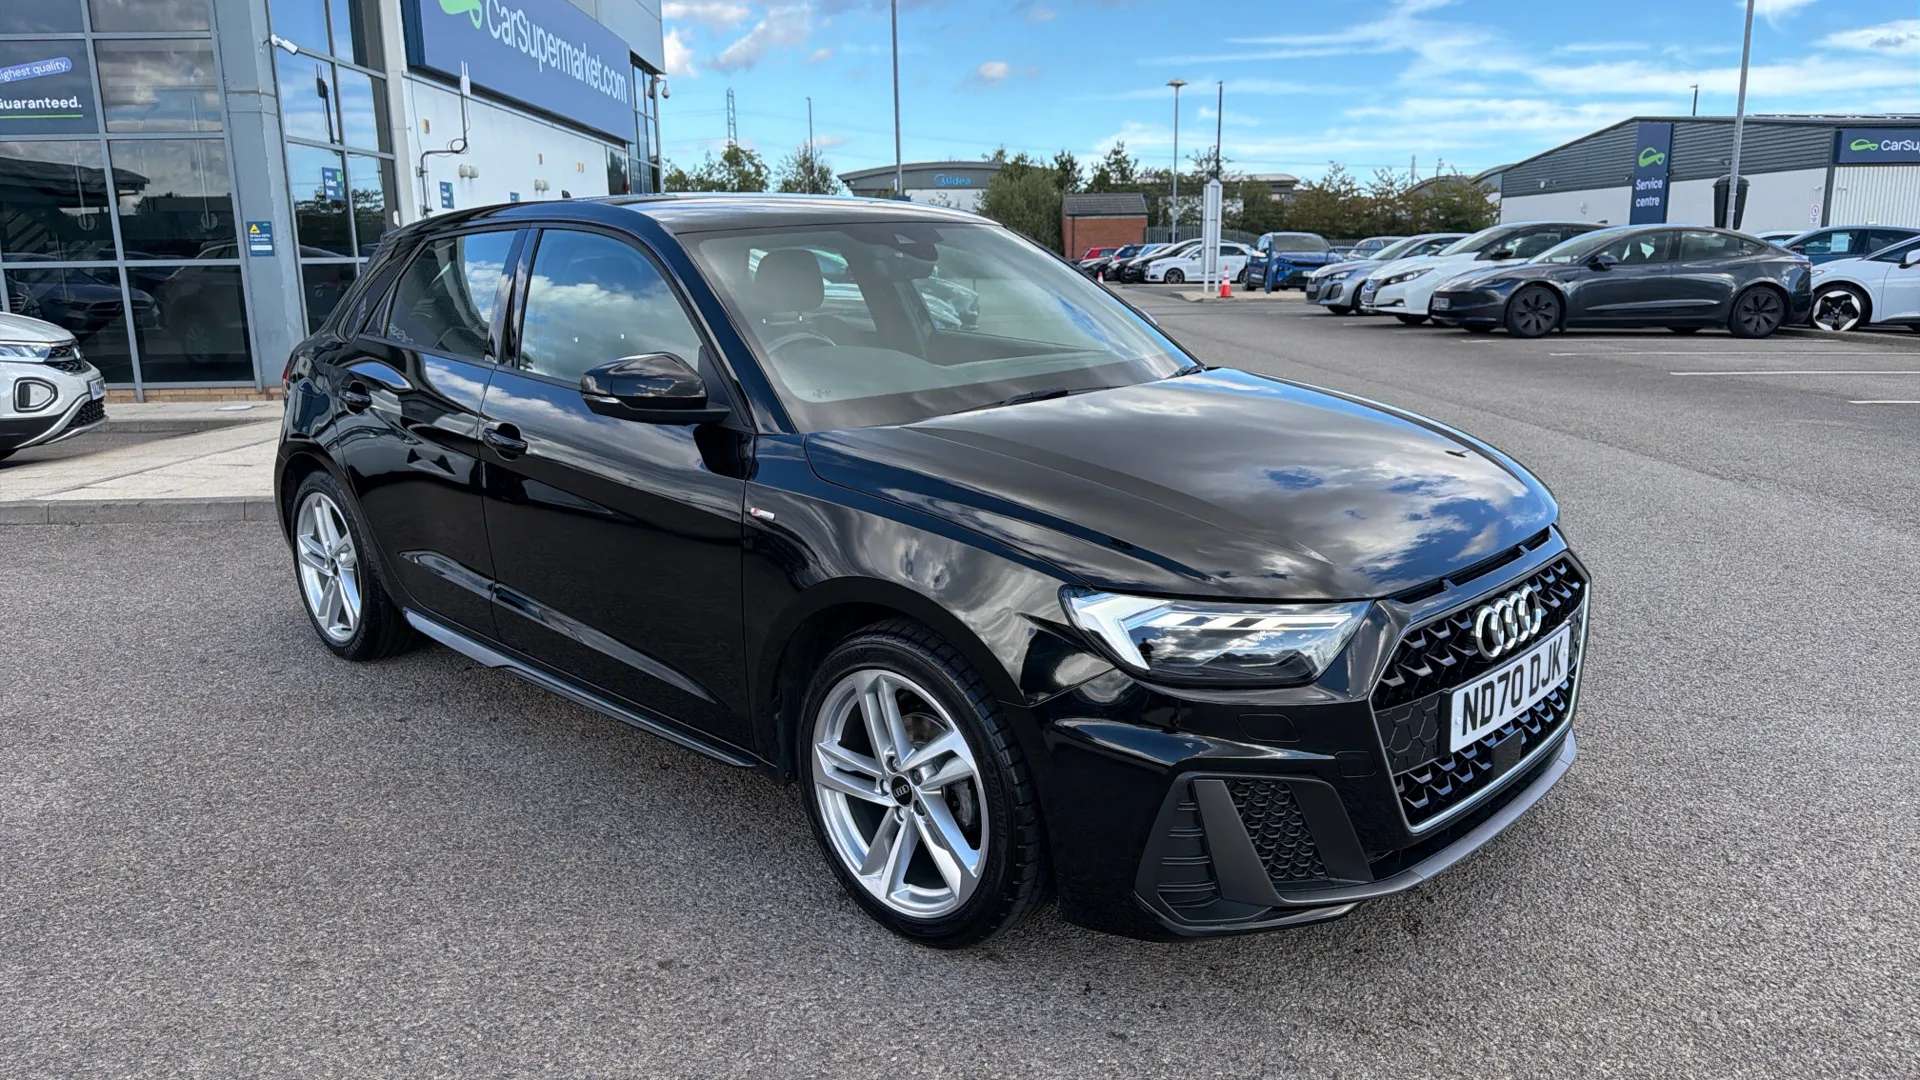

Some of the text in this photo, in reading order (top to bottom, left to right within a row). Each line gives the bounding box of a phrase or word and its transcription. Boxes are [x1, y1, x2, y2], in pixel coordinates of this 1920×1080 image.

[486, 0, 627, 104] CarSupermarket.com
[0, 60, 69, 82] ighest quality.
[1880, 139, 1920, 154] CarSu
[1635, 177, 1663, 191] Service
[1635, 195, 1660, 208] centre
[1462, 636, 1562, 736] ND70 DJK
